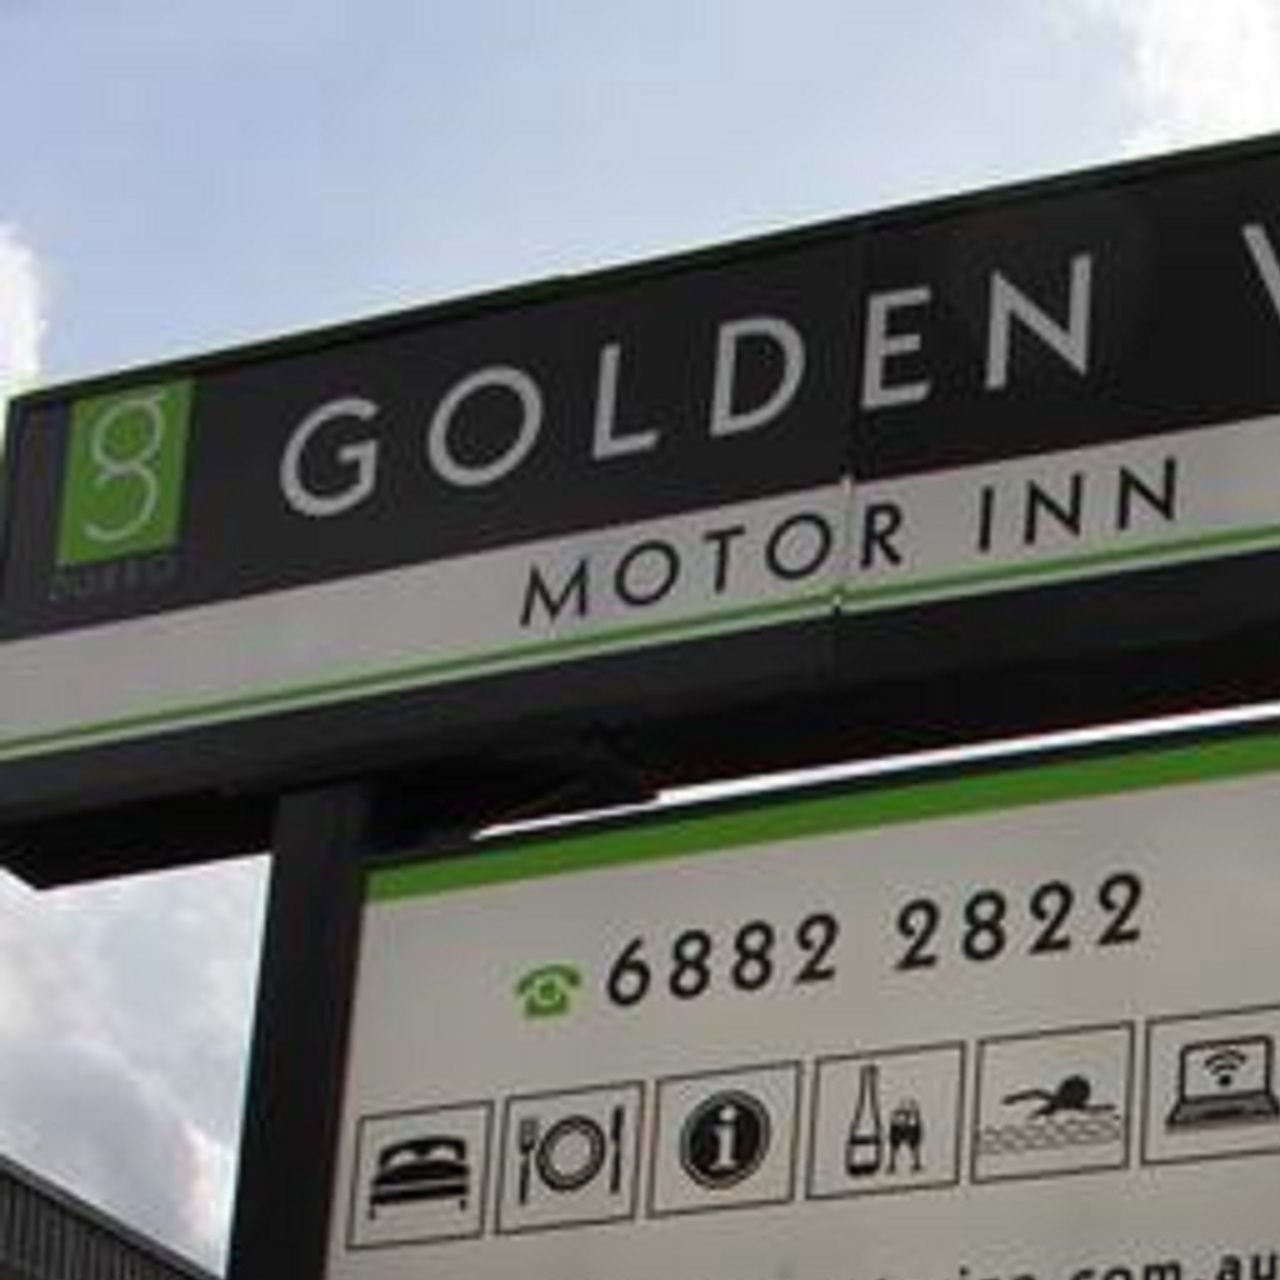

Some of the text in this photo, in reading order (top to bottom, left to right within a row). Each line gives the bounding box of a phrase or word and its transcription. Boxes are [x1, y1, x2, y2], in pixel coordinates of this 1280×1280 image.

[278, 258, 1090, 517] GOLDEN
[520, 456, 1178, 627] MOTOR INN
[605, 871, 1144, 1008] 6882 2822
